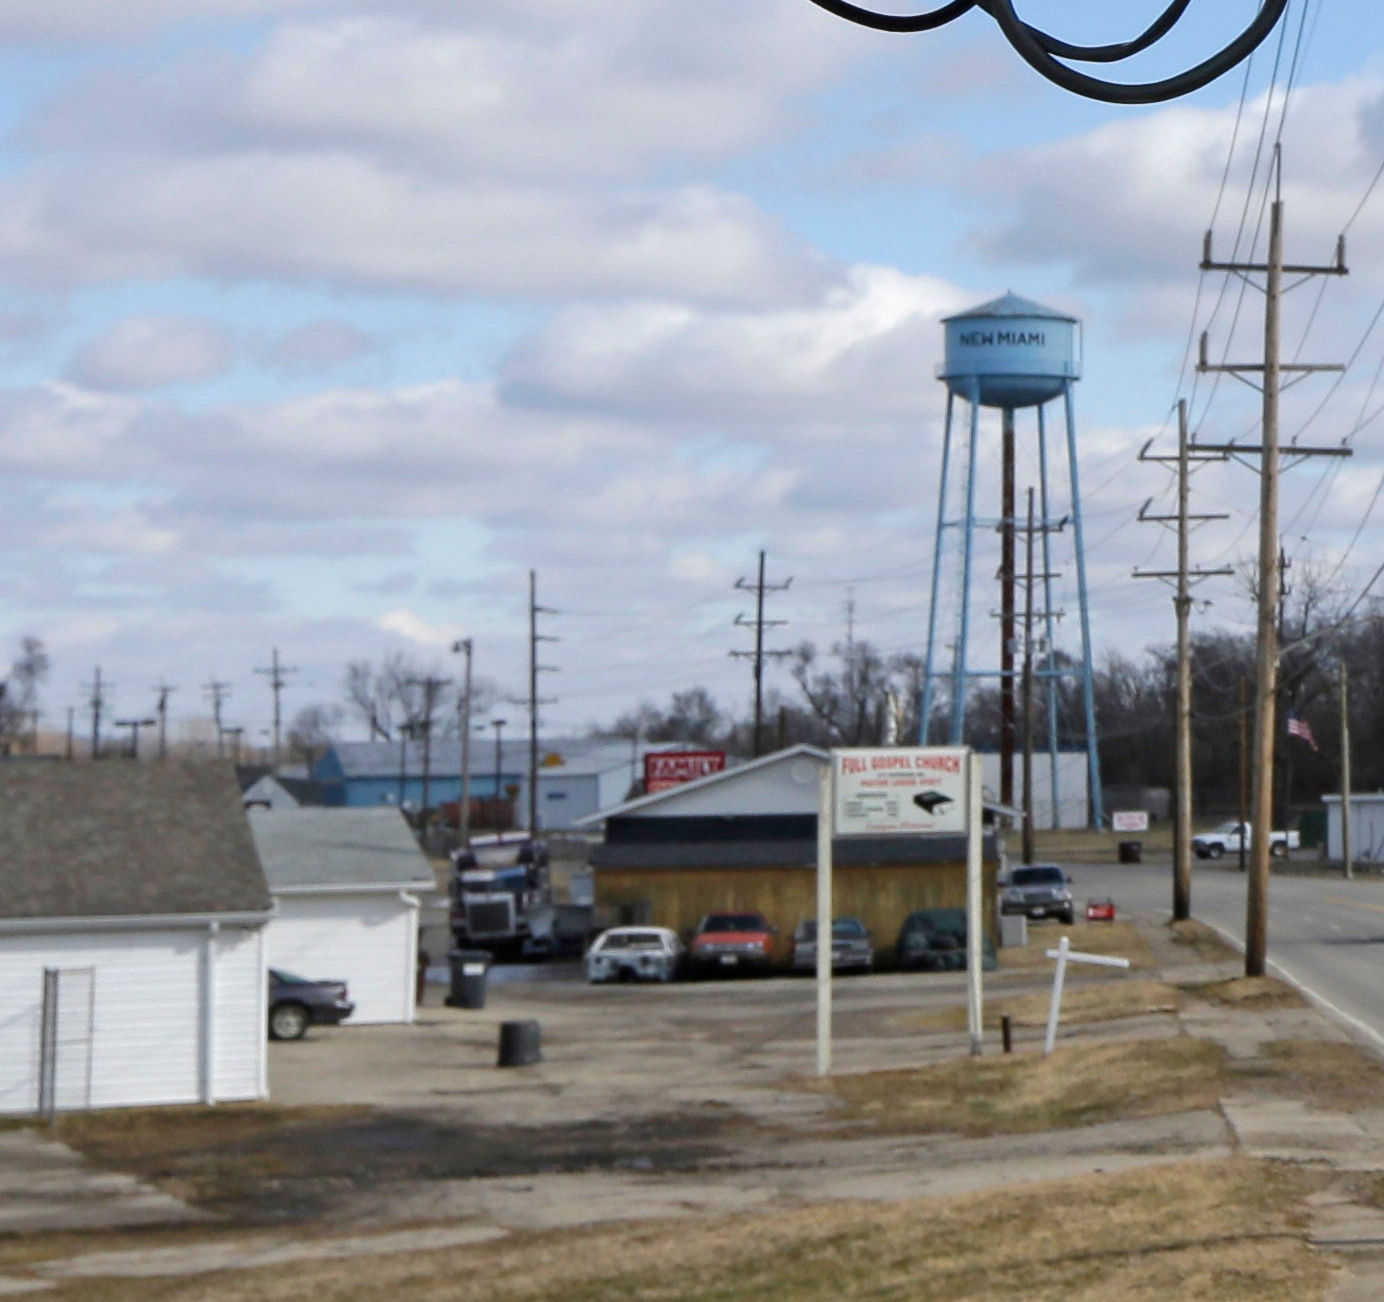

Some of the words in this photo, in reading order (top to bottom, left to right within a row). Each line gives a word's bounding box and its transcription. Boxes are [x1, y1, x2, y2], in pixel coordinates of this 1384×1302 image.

[959, 330, 993, 347] NEW
[997, 330, 1045, 347] MIAMI
[841, 756, 868, 775] FULL
[870, 756, 911, 770] GOSPEL
[914, 756, 961, 773] CHURCH
